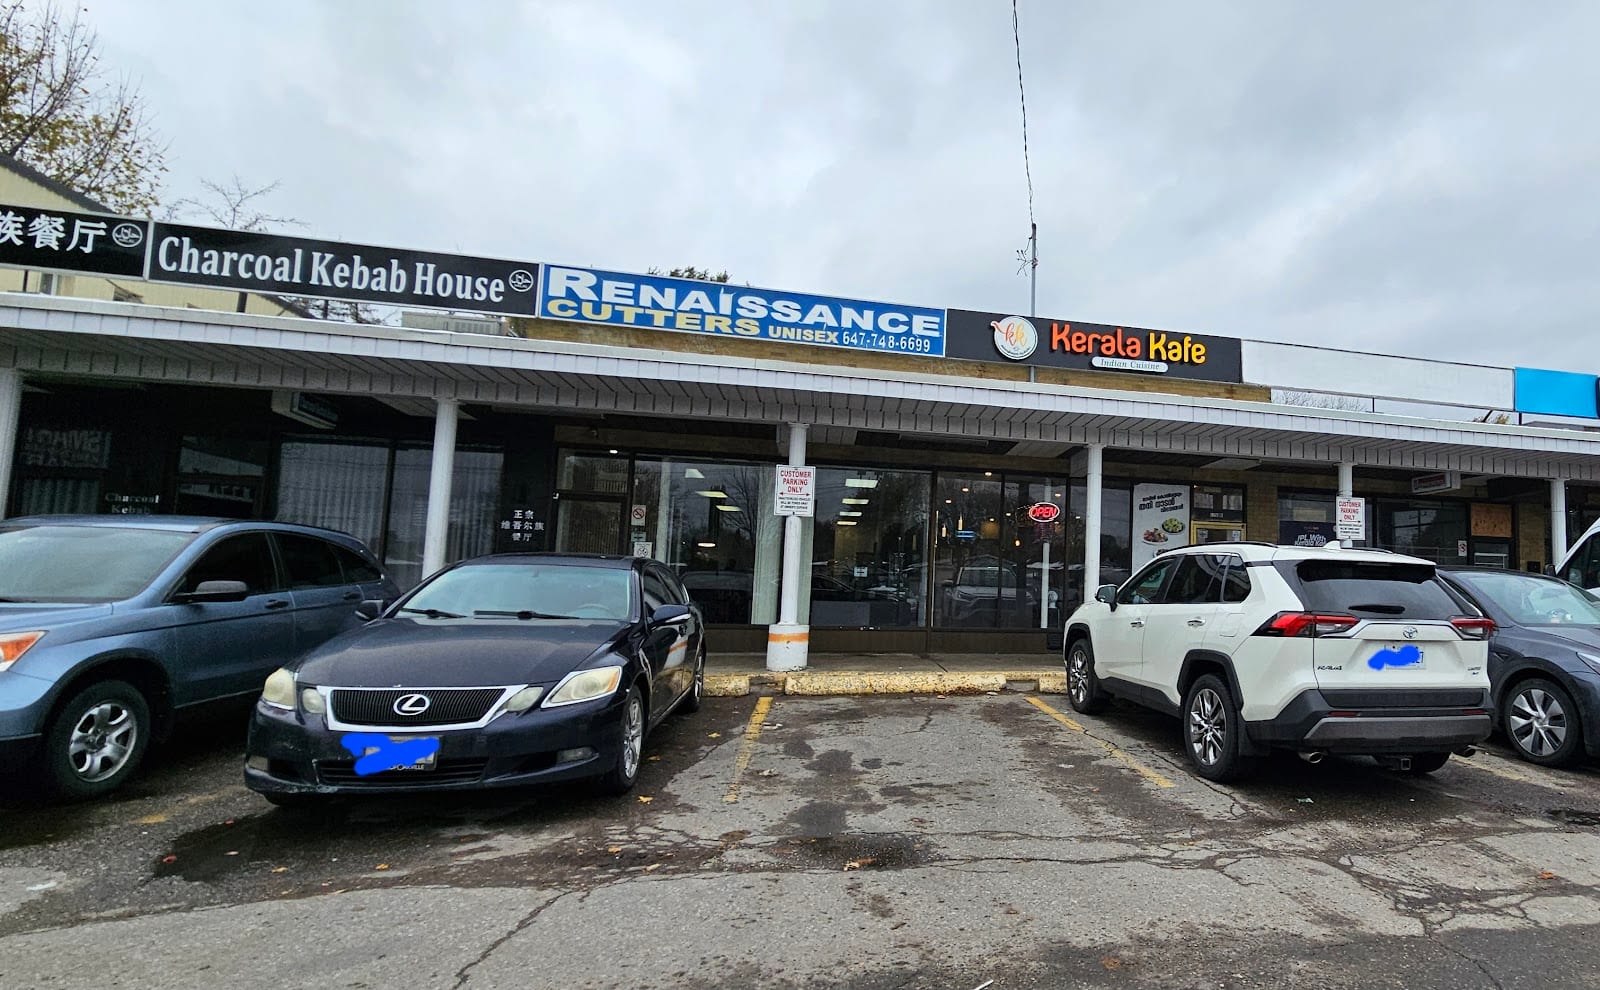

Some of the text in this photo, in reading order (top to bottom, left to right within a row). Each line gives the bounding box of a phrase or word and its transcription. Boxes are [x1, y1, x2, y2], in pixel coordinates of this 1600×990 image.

[158, 236, 505, 302] Charcoal Kebab House
[548, 267, 942, 338] RENAISSANCE
[547, 299, 931, 353] CUTTERS UNISEX 647-748-6699
[1052, 322, 1206, 364] Kerala Kafe
[1100, 358, 1160, 371] Indian Cuisine
[780, 470, 812, 478] CUSTOMER
[783, 478, 808, 486] PARKING
[1031, 506, 1057, 518] OPEN
